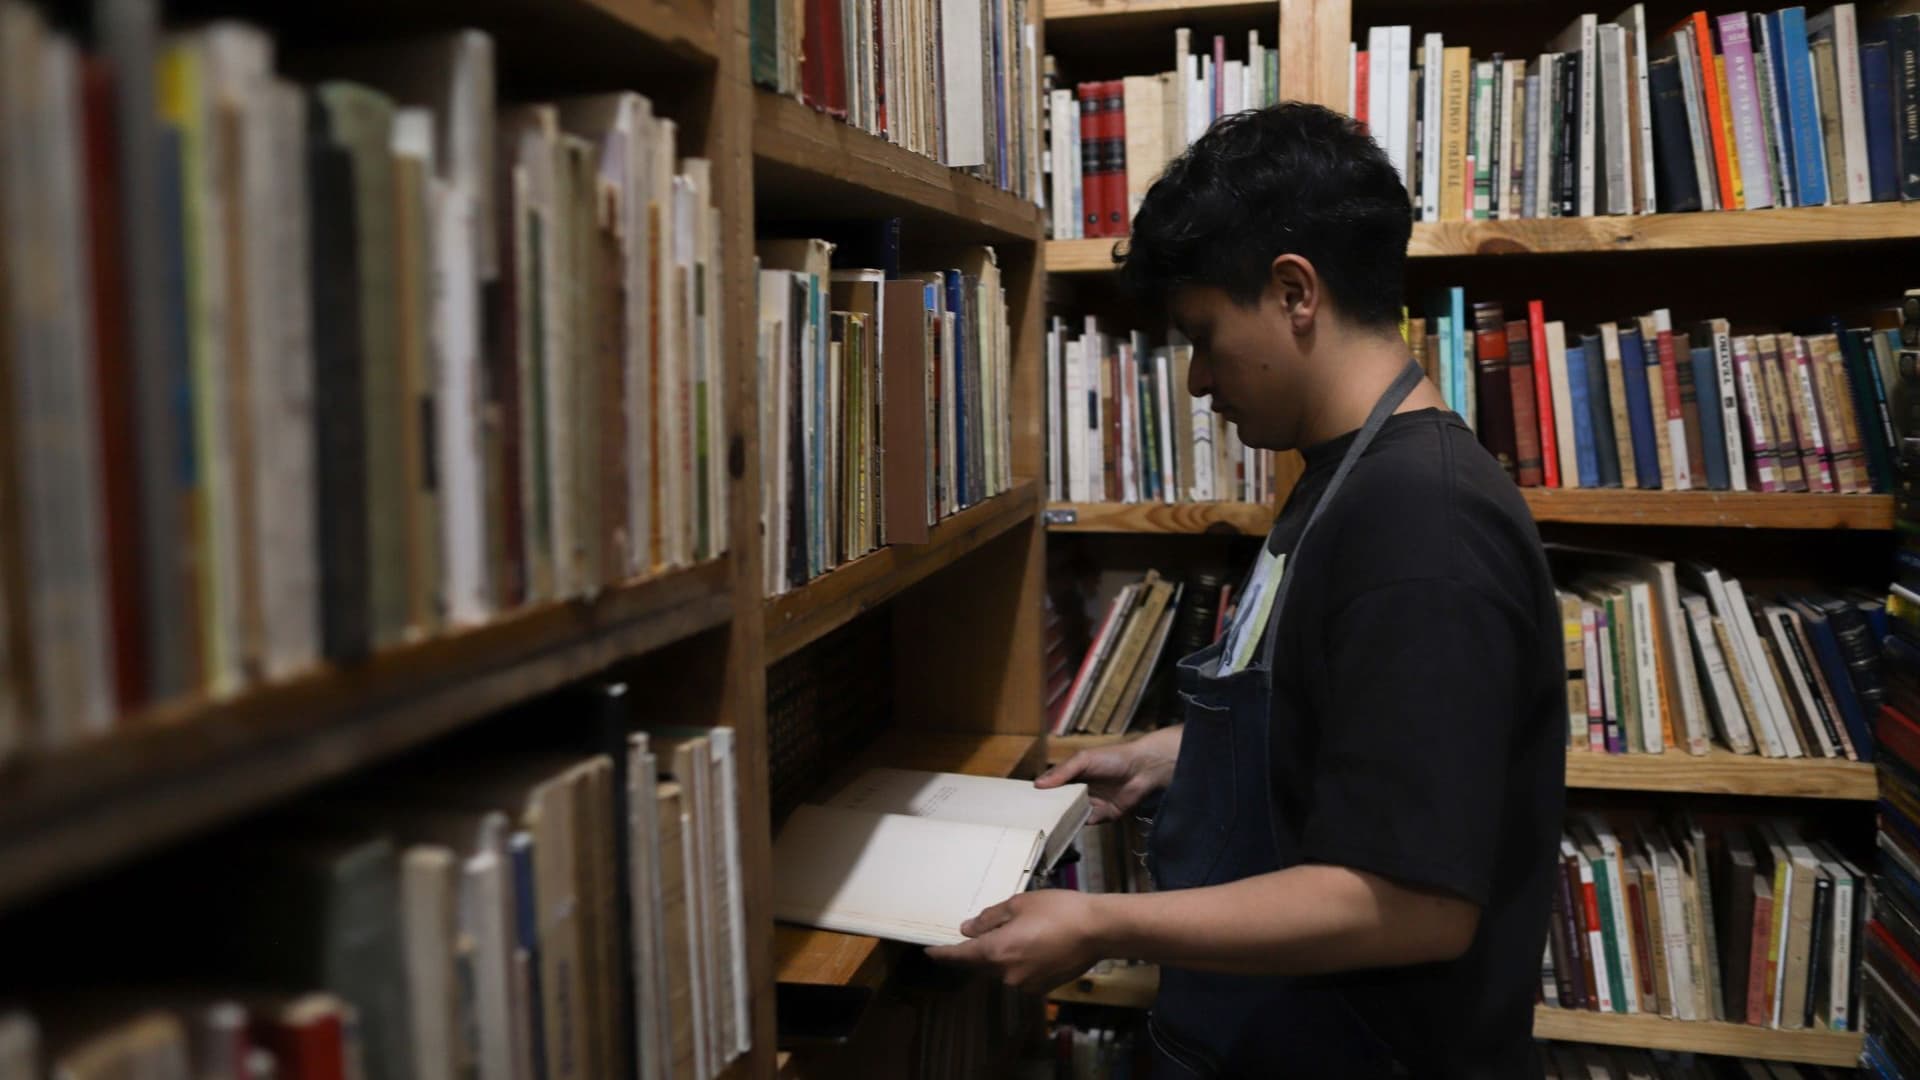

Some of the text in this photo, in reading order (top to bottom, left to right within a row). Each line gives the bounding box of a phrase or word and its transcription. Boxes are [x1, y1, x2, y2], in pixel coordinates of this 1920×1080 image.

[1735, 56, 1746, 89] AZAR
[1905, 50, 1915, 89] TEATRO
[1448, 69, 1462, 186] TEATRO COMPLETO
[1741, 117, 1753, 165] TEATRO
[1719, 335, 1731, 385] TEATRO
